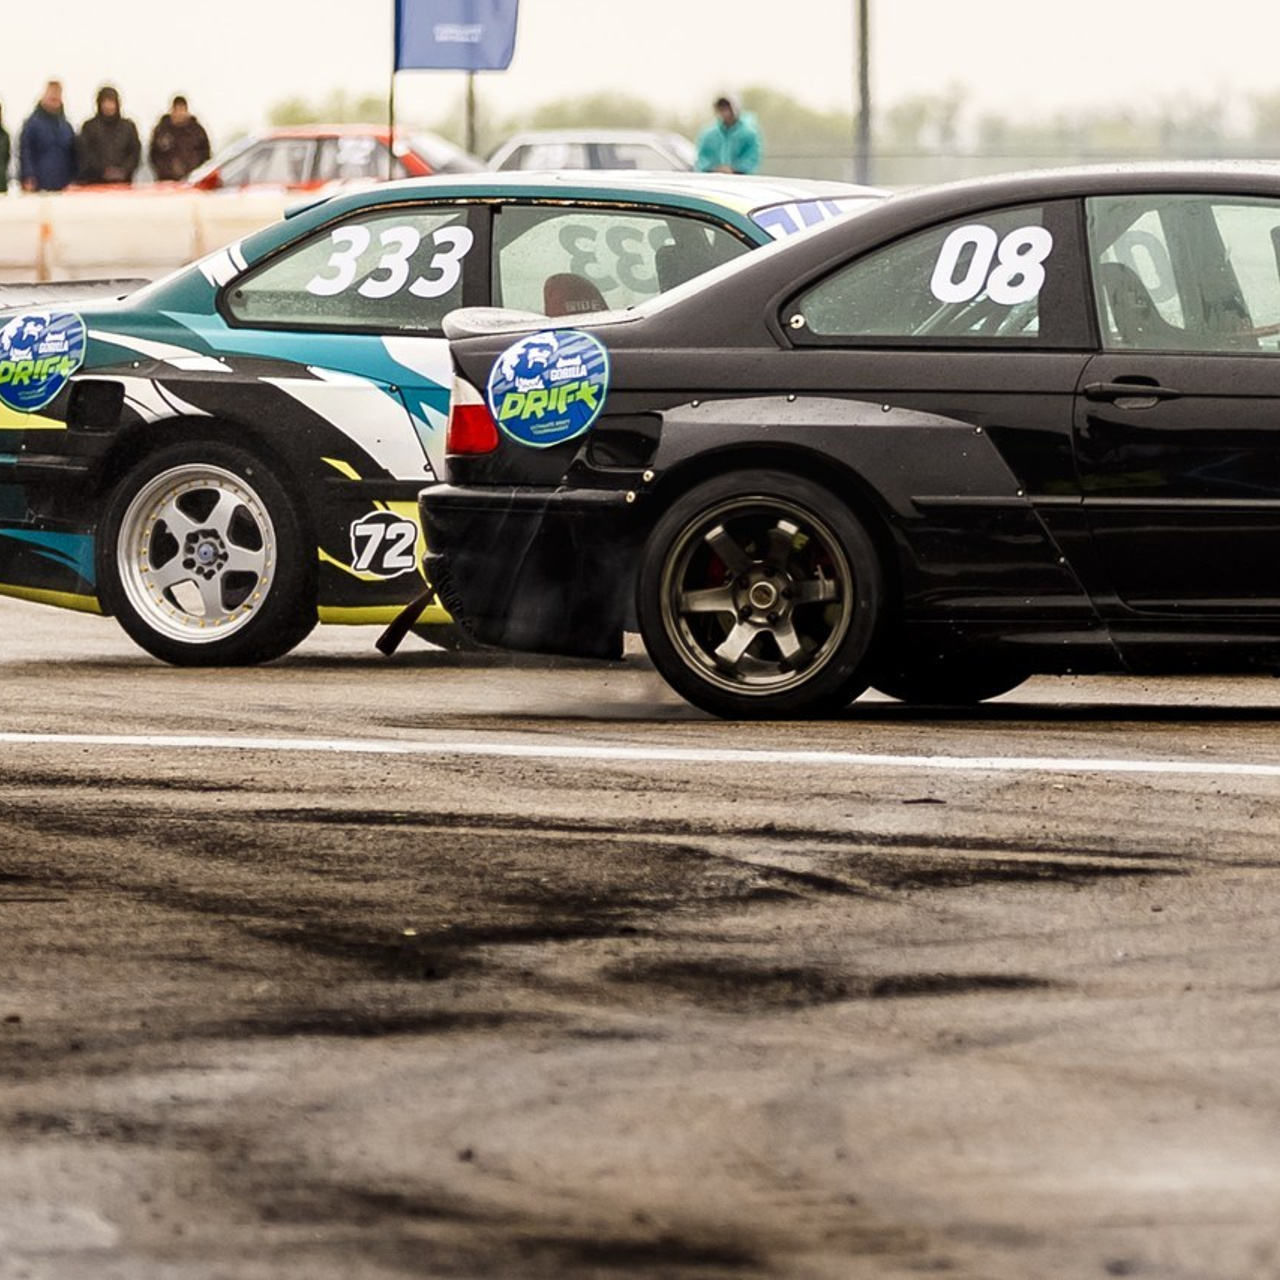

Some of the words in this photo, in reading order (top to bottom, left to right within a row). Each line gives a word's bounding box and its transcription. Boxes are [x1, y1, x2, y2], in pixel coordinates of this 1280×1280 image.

[306, 225, 474, 298] 333
[930, 224, 1054, 305] 08
[550, 364, 588, 381] GORILLA
[355, 521, 416, 570] 72
